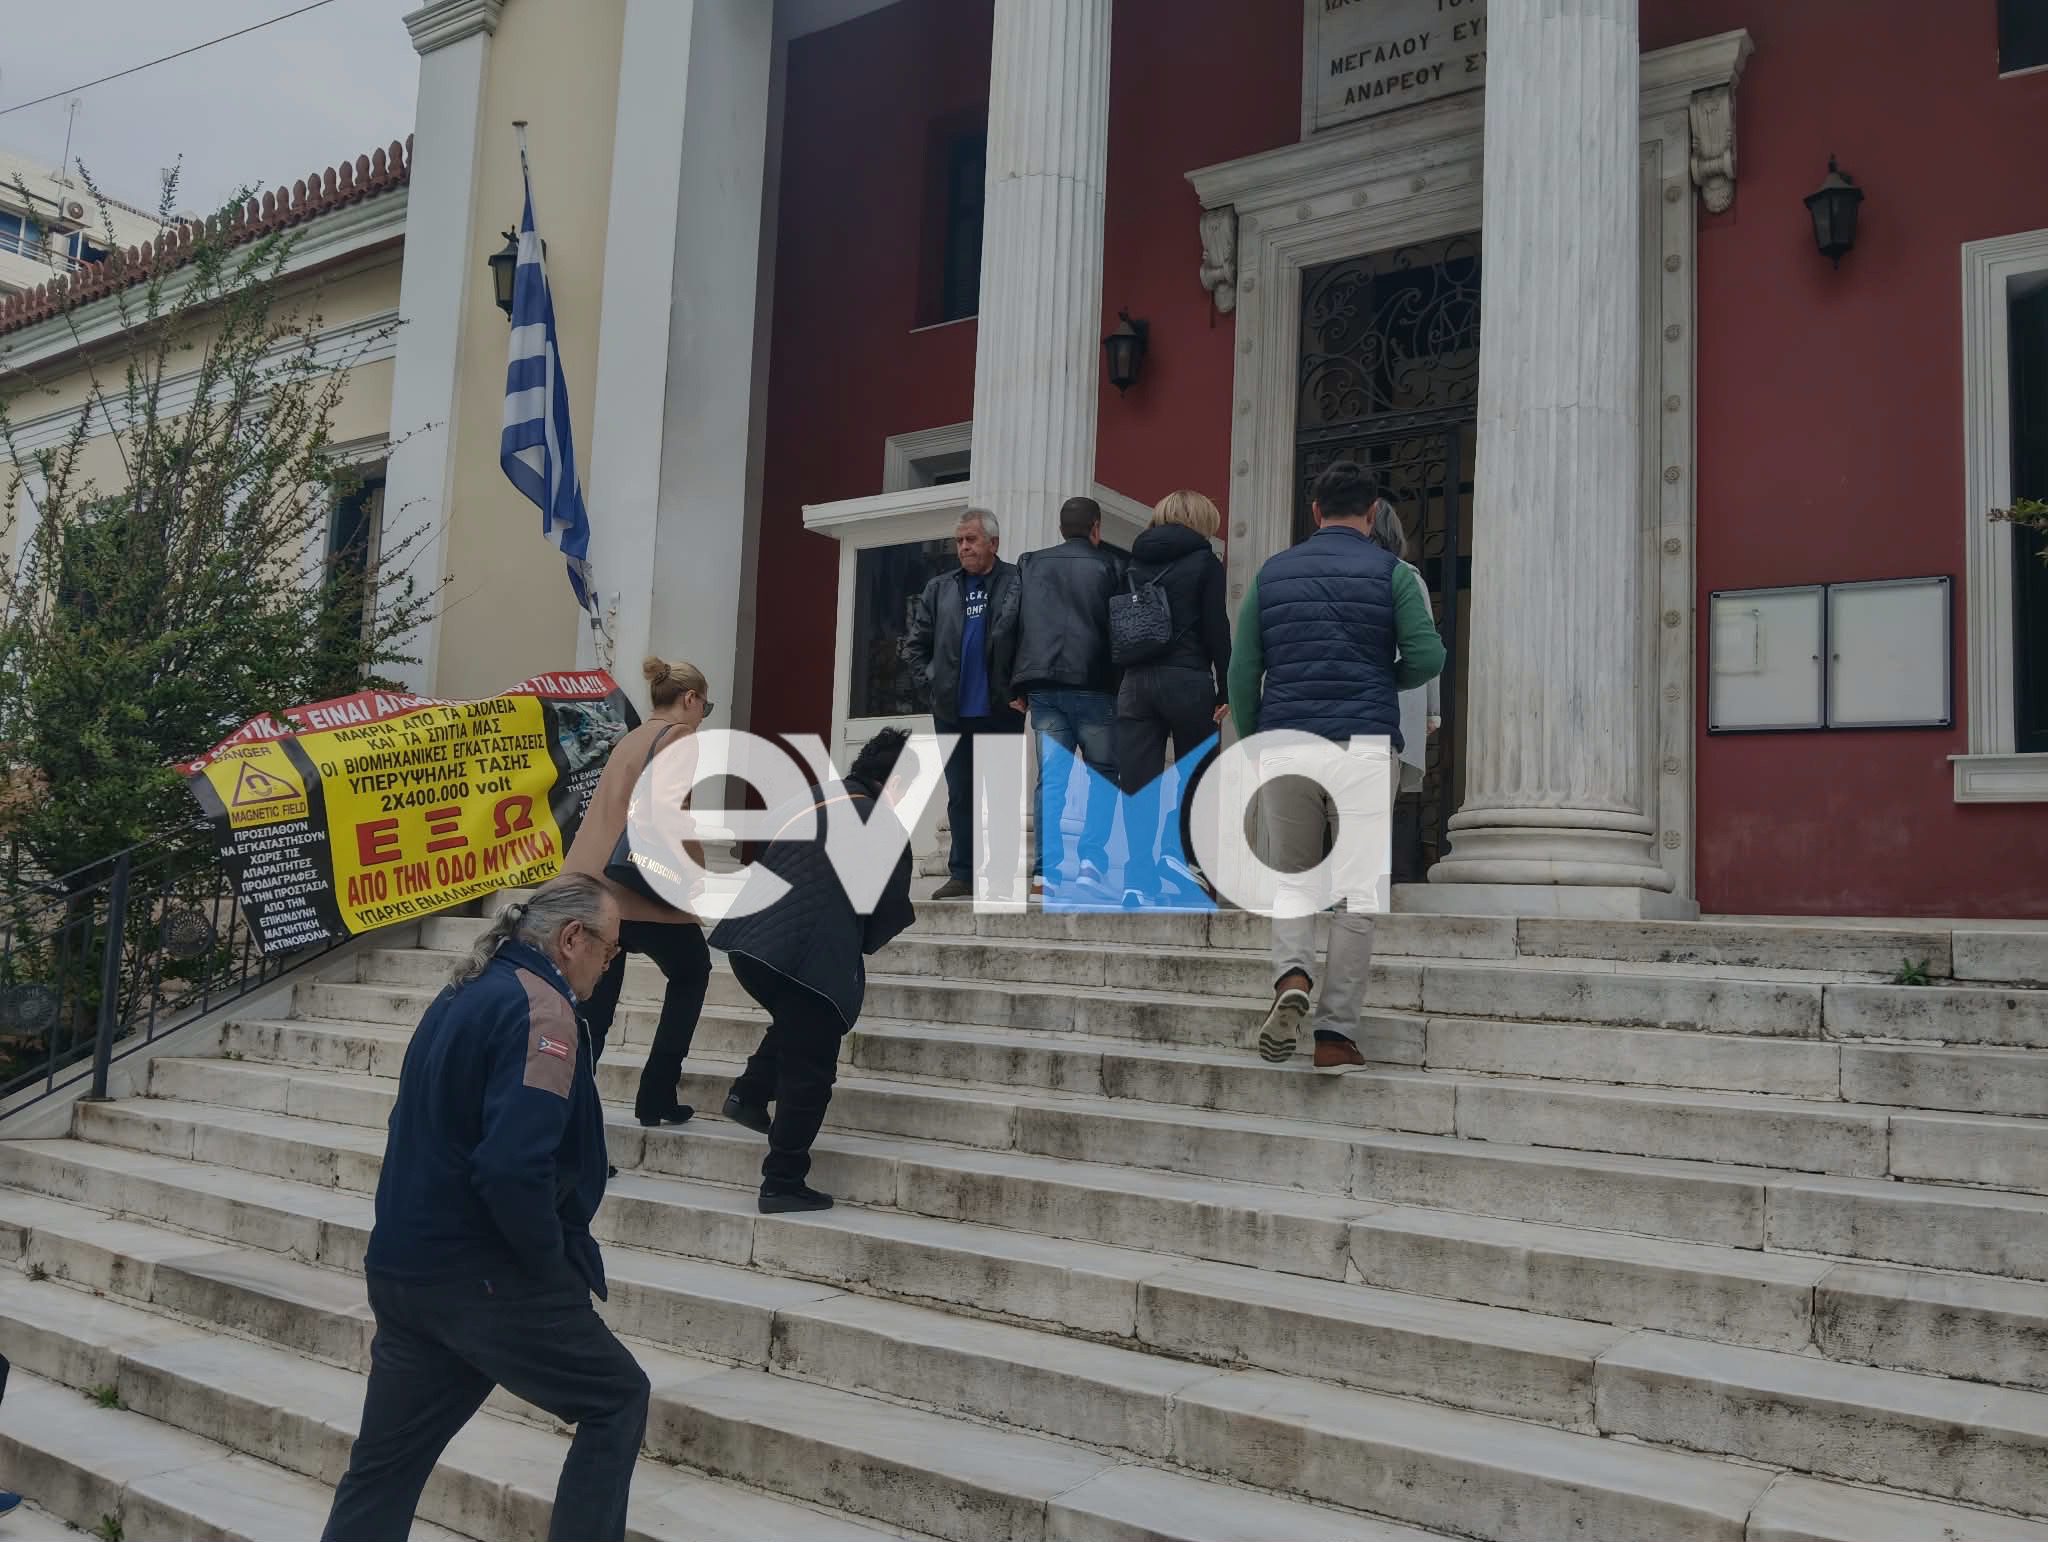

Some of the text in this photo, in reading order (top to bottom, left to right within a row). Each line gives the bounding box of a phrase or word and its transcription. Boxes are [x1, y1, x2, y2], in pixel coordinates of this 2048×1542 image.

[1330, 15, 1487, 77] ΜΕΓΑΛΟΥ ΕΥ
[1344, 62, 1443, 106] ΑΝΔΡΕΟΥ
[307, 700, 372, 730] ΕΙΝΑΙ
[530, 676, 561, 694] ΓΙΑ
[334, 698, 517, 743] ΜΑΚΡΙΑ ΑΠΟ ΤΑ ΣΧΟΛΕΙΑ
[366, 717, 502, 751] ΚΑΙ ΤΑ ΣΠΙΤΙΑ ΜΑΣ
[321, 733, 545, 778] ΟΙ ΒΙΟΜΗΧΑΝΙΚΕΣ ΕΓΚΑΤΑΣΤΑΣΕΙΣ
[348, 753, 532, 795] ΥΠΕΡΥΨΗΛΗΣ ΤΑΣΗΣ
[579, 767, 604, 780] ΕΚΘΕ
[476, 776, 512, 795] volt
[231, 802, 306, 824] MAGNETIC FIELD
[234, 821, 308, 842] ΠΡΟΣΠΑΘΟΥΝ
[220, 831, 325, 857] ΝΑ ΕΓΚΑΤΑΣΤΗΣΟΥΝ
[250, 847, 300, 865] ΧΩΡΙΣ ΤΙΣ
[627, 851, 648, 868] LOVE
[243, 858, 312, 879] ΑΠΑΡΑΙΤΗΤΕΣ
[347, 830, 555, 907] ΑΠΟ ΤΗΝ ΟΔΟ ΜΥΤΙΚΑ
[241, 869, 318, 892] ΠΡΟΔΙΑΓΡΑΦΕΣ
[253, 891, 273, 903] ΤΗΝ
[274, 880, 328, 899] ΠΡΟΣΤΑΣΙΑ
[264, 896, 306, 913] ΑΠΟ ΤΗΝ
[355, 860, 559, 926] ΥΠΑΡΧΕΙ ΕΝΑΛΛΑΚΤΙΚΗ ΟΔΕΥΣΗ
[260, 906, 317, 927] ΕΠΙΚΙΝΔΥΝΗ
[263, 919, 320, 940] ΜΑΓΝΗΤΙΚΗ
[264, 929, 331, 953] ΑΚΤΙΝΟΒΟΛΙΑ
